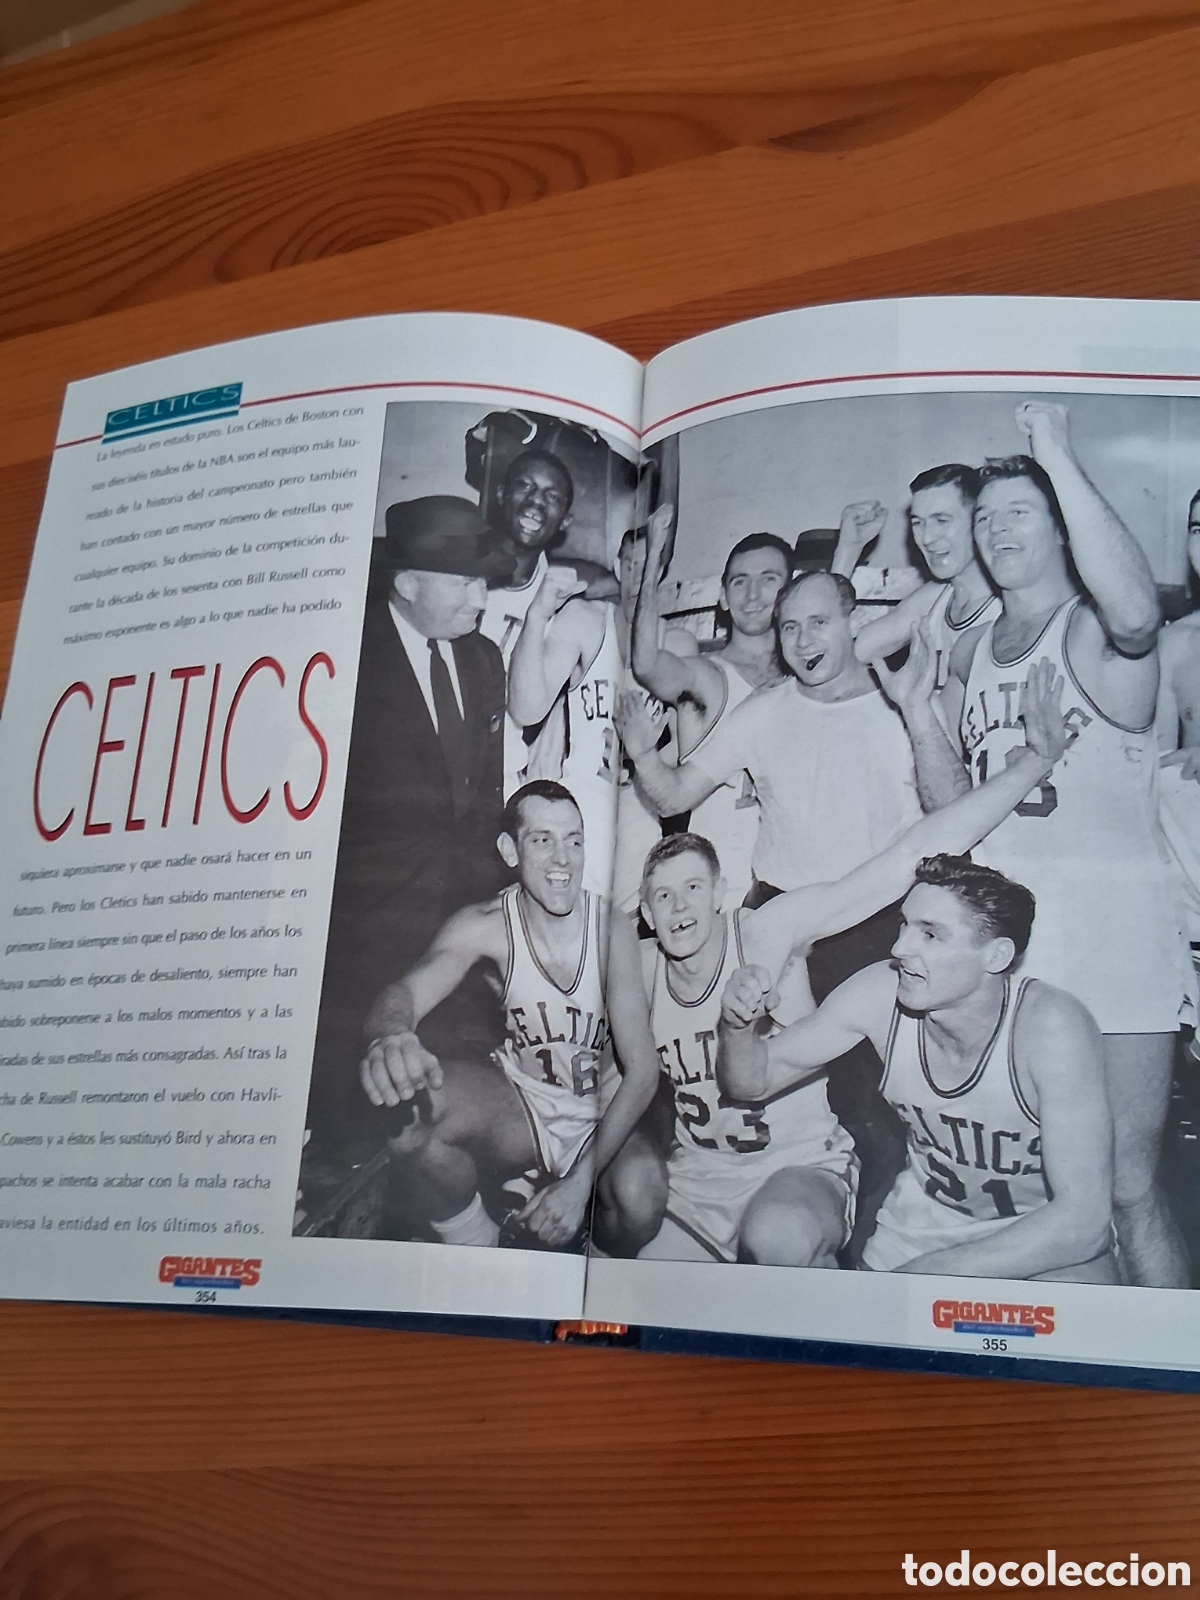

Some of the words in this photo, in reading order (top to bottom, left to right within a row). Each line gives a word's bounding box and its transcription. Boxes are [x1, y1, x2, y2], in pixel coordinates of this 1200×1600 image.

[108, 385, 240, 425] CELTICS
[96, 452, 108, 462] La
[148, 441, 161, 450] en
[227, 425, 244, 435] Los
[247, 417, 282, 431] Celtics
[285, 413, 299, 424] de
[302, 410, 339, 422] Boston
[342, 407, 364, 417] con
[182, 461, 195, 472] de
[197, 459, 207, 469] la
[210, 454, 234, 467] NBA
[237, 452, 256, 462] son
[258, 447, 269, 458] el
[271, 444, 309, 457] equipo
[312, 439, 335, 451] más
[338, 437, 360, 448] lau-
[116, 504, 129, 514] de
[132, 501, 142, 511] la
[187, 488, 204, 501] del
[208, 479, 275, 497] campeonato
[278, 476, 305, 489] pero
[310, 468, 357, 482] también
[101, 531, 141, 547] contado
[143, 529, 163, 539] con
[165, 526, 180, 535] un
[182, 519, 216, 532] mayor
[219, 513, 261, 526] número
[264, 508, 278, 519] de
[282, 502, 327, 517] estrellas
[331, 502, 353, 514] que
[162, 555, 176, 566] Su
[178, 548, 222, 564] dominio
[225, 545, 239, 556] de
[242, 543, 252, 553] la
[255, 535, 326, 552] competición
[329, 532, 349, 544] du-
[95, 598, 105, 608] la
[108, 591, 144, 606] década
[146, 588, 160, 600] de
[163, 586, 178, 597] los
[181, 581, 219, 594] sesenta
[222, 578, 243, 588] con
[246, 572, 265, 585] Bill
[312, 568, 346, 578] como
[159, 621, 171, 629] es
[173, 615, 197, 629] algo
[199, 615, 206, 624] a
[209, 611, 220, 622] lo
[223, 610, 244, 622] que
[247, 604, 279, 617] nadie
[282, 602, 296, 613] ha
[300, 598, 342, 614] podido
[33, 652, 336, 842] CELTICS
[129, 862, 137, 873] y
[140, 859, 162, 872] que
[165, 853, 197, 867] nadie
[201, 851, 232, 865] osará
[236, 849, 271, 862] hacer
[274, 851, 290, 861] en
[295, 850, 312, 860] un
[51, 901, 76, 913] Pero
[79, 899, 96, 911] los
[142, 893, 164, 906] han
[169, 890, 209, 904] sabido
[213, 889, 286, 901] mantenerse
[291, 889, 307, 898] en
[77, 937, 120, 949] siempre
[121, 932, 139, 945] sin
[141, 934, 163, 946] que
[165, 929, 177, 942] el
[179, 931, 208, 944] paso
[210, 927, 226, 940] de
[229, 926, 247, 939] los
[250, 926, 280, 938] años
[284, 924, 303, 937] los
[69, 976, 84, 986] en
[130, 969, 146, 983] de
[149, 967, 212, 982] desaliento,
[218, 966, 268, 981] siempre
[273, 963, 298, 977] han
[104, 1013, 113, 1023] a
[117, 1009, 134, 1022] los
[138, 1007, 173, 1021] malos
[178, 1007, 242, 1020] momentos
[247, 1009, 256, 1021] y
[260, 1008, 268, 1018] a
[275, 1004, 293, 1018] las
[31, 1052, 46, 1065] de
[67, 1049, 113, 1064] estrellas
[115, 1049, 139, 1062] más
[142, 1046, 219, 1064] consagradas.
[223, 1046, 245, 1059] Así
[248, 1048, 271, 1059] tras
[275, 1045, 287, 1059] la
[535, 1049, 599, 1097] 16
[20, 1092, 35, 1105] de
[81, 1092, 149, 1104] remontaron
[153, 1088, 166, 1103] el
[171, 1087, 206, 1102] vuelo
[210, 1091, 235, 1102] con
[677, 1091, 771, 1153] 23
[47, 1136, 55, 1148] y
[56, 1135, 64, 1145] a
[99, 1131, 116, 1145] les
[175, 1130, 202, 1144] Bird
[205, 1134, 215, 1148] y
[217, 1130, 255, 1145] ahora
[259, 1135, 277, 1145] en
[103, 1173, 145, 1188] acabar
[148, 1177, 172, 1188] con
[177, 1173, 189, 1188] la
[194, 1173, 227, 1188] mala
[233, 1174, 271, 1189] racha
[41, 1215, 53, 1230] la
[58, 1216, 110, 1231] entidad
[113, 1220, 131, 1231] en
[136, 1216, 157, 1232] los
[163, 1217, 217, 1233] últimos
[223, 1220, 264, 1235] años.
[159, 1256, 262, 1287] GIGANTES
[195, 1290, 217, 1303] 354
[933, 1299, 1055, 1335] GIGANTES
[982, 1338, 1008, 1351] 355
